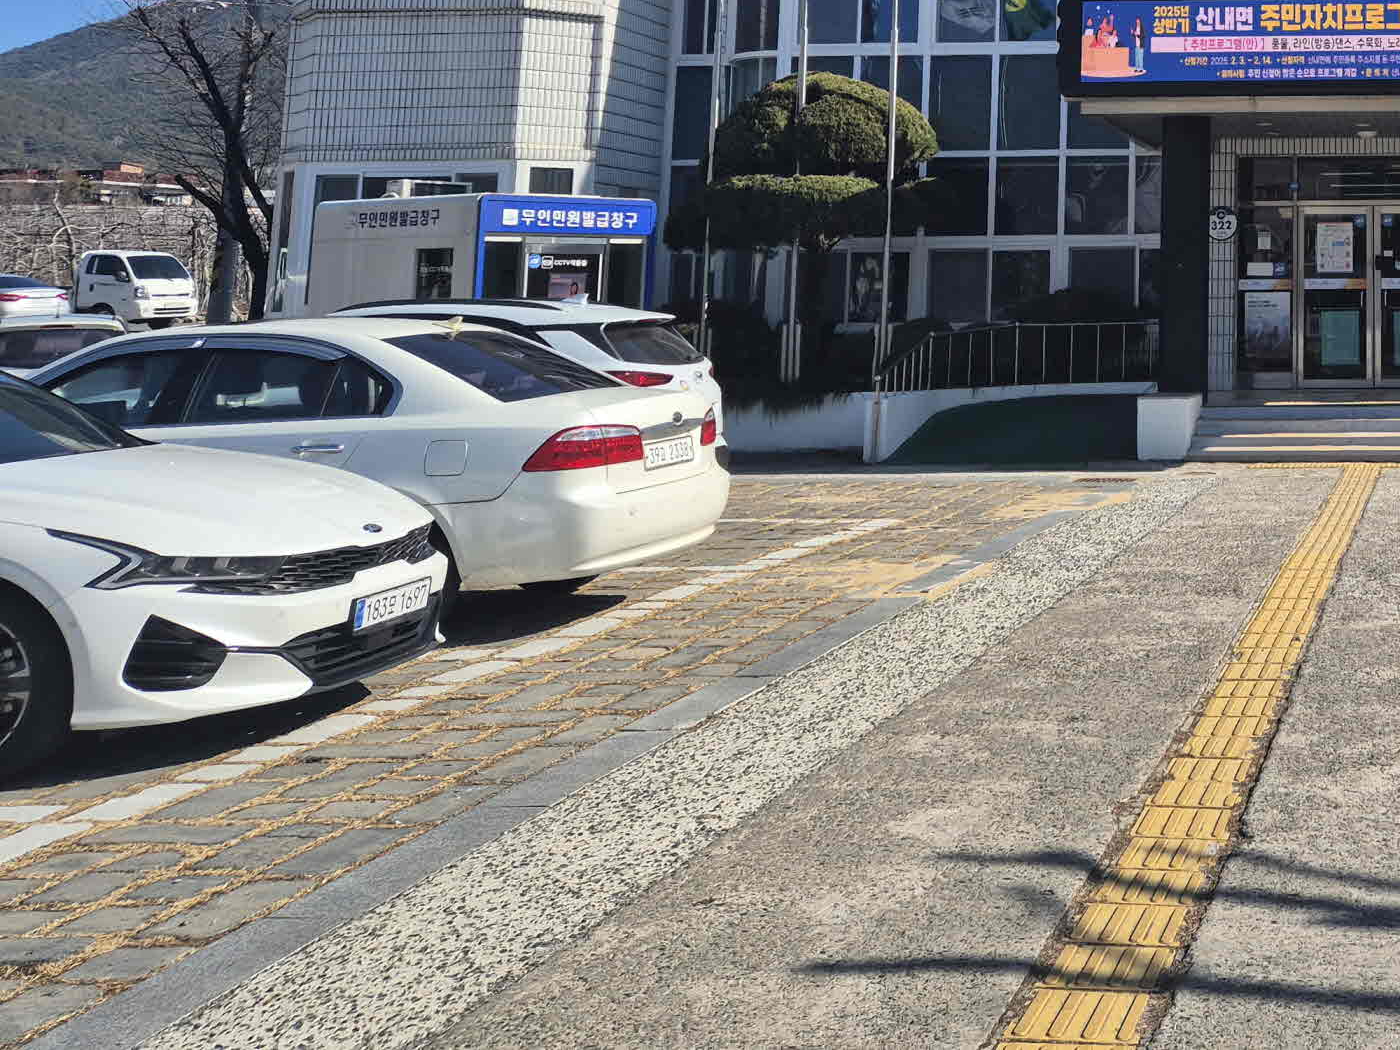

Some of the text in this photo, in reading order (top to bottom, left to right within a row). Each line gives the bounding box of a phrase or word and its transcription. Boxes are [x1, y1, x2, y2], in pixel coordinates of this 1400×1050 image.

[1153, 5, 1190, 18] 2025년
[1195, 6, 1253, 31] 산내면
[1153, 18, 1190, 35] 상반기
[1271, 37, 1291, 51] 풍물,
[1293, 37, 1355, 51] 라인(방송)댄스,
[1357, 37, 1385, 51] 수묵화,
[358, 208, 440, 229] 무인민원발급창구
[520, 208, 639, 229] 무인민원발급창구
[1211, 220, 1233, 231] 322
[401, 583, 428, 611] 1697
